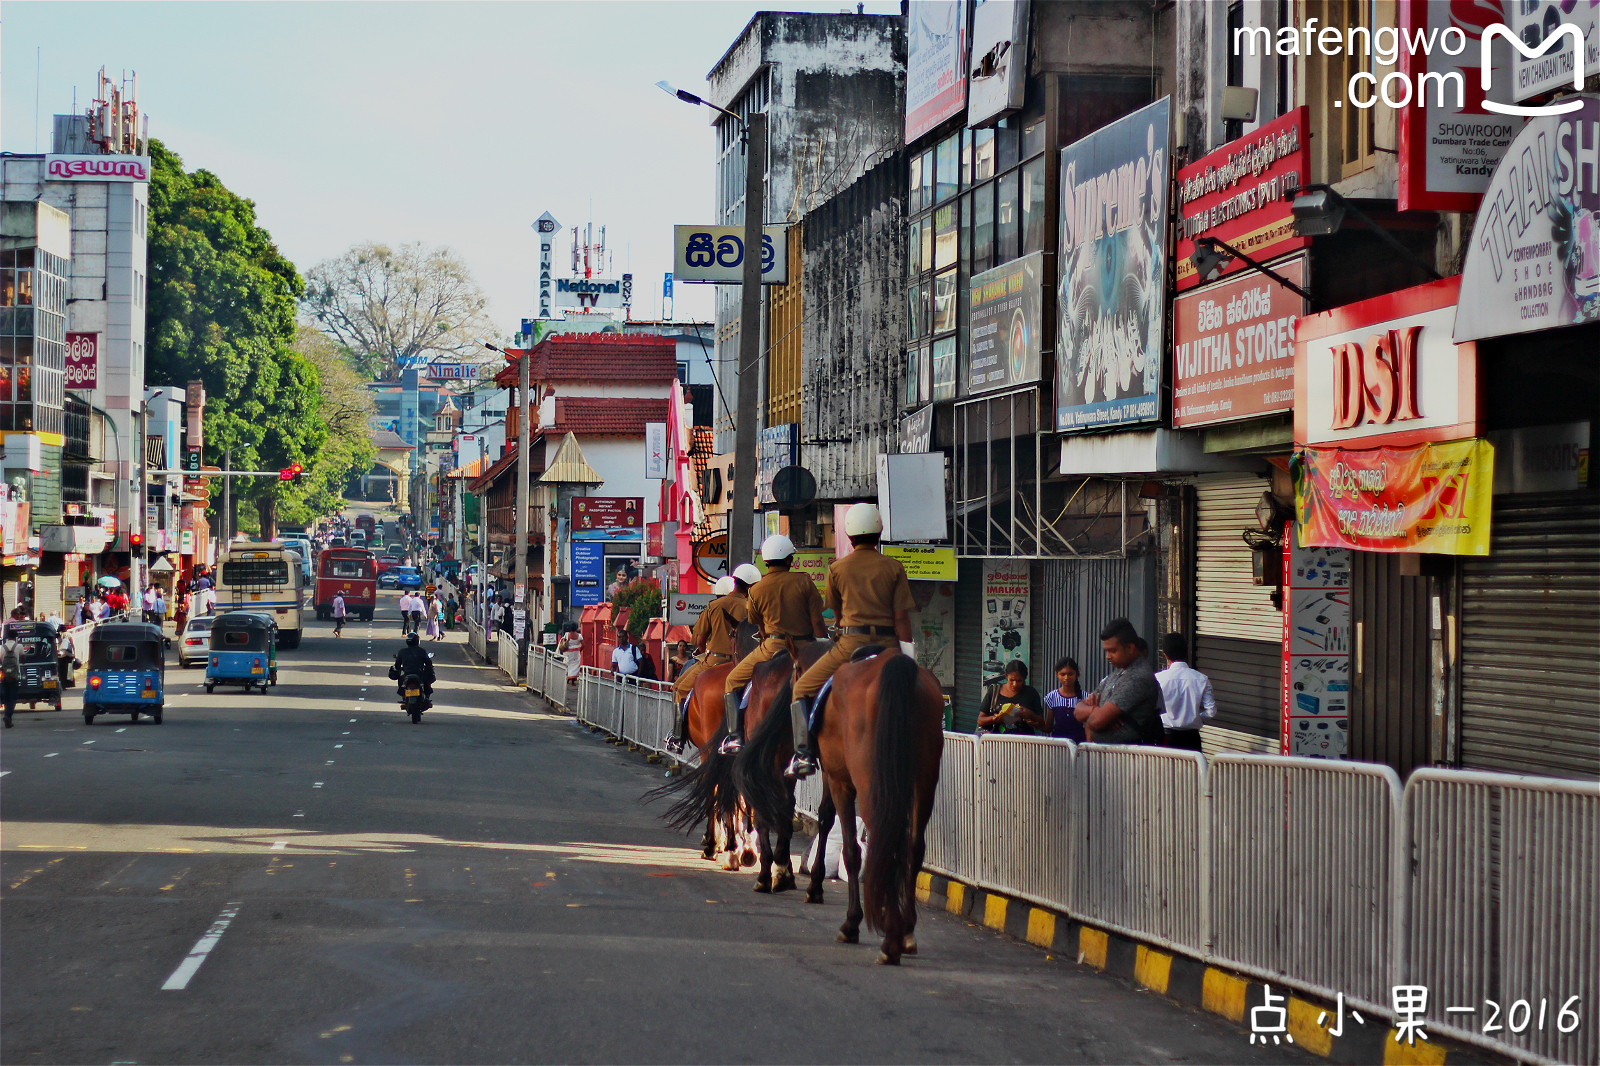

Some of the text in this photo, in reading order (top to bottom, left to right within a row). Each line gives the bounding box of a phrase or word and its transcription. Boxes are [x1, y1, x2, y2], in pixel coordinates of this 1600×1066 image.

[1519, 67, 1530, 89] NEW
[1531, 54, 1559, 85] CHANDANI
[1438, 123, 1512, 138] SHOWROOM
[1432, 137, 1467, 146] Dumbara
[1469, 138, 1491, 147] Trade
[1462, 147, 1488, 157] No:06,
[1440, 156, 1501, 166] Yatinuwara Veed
[1456, 164, 1494, 178] Kandy
[1063, 123, 1163, 270] Supreme's
[1480, 131, 1552, 283] THAI
[1513, 241, 1552, 263] CONTEMPORARY
[540, 243, 551, 318] DINAPALA
[557, 279, 620, 294] National
[622, 273, 633, 301] SONY
[577, 293, 600, 307] TV
[1520, 301, 1549, 320] COLLECTION
[1176, 314, 1297, 380] VIJITHA STORES
[428, 365, 476, 378] Nimalie
[1328, 325, 1426, 431] DSI
[1174, 385, 1187, 398] Dealers
[1253, 369, 1270, 386] products
[1219, 398, 1232, 412] Kandy
[281, 470, 292, 480] 25
[1419, 472, 1470, 520] DSI
[708, 542, 727, 555] NS
[987, 586, 1029, 594] IMALKA'S
